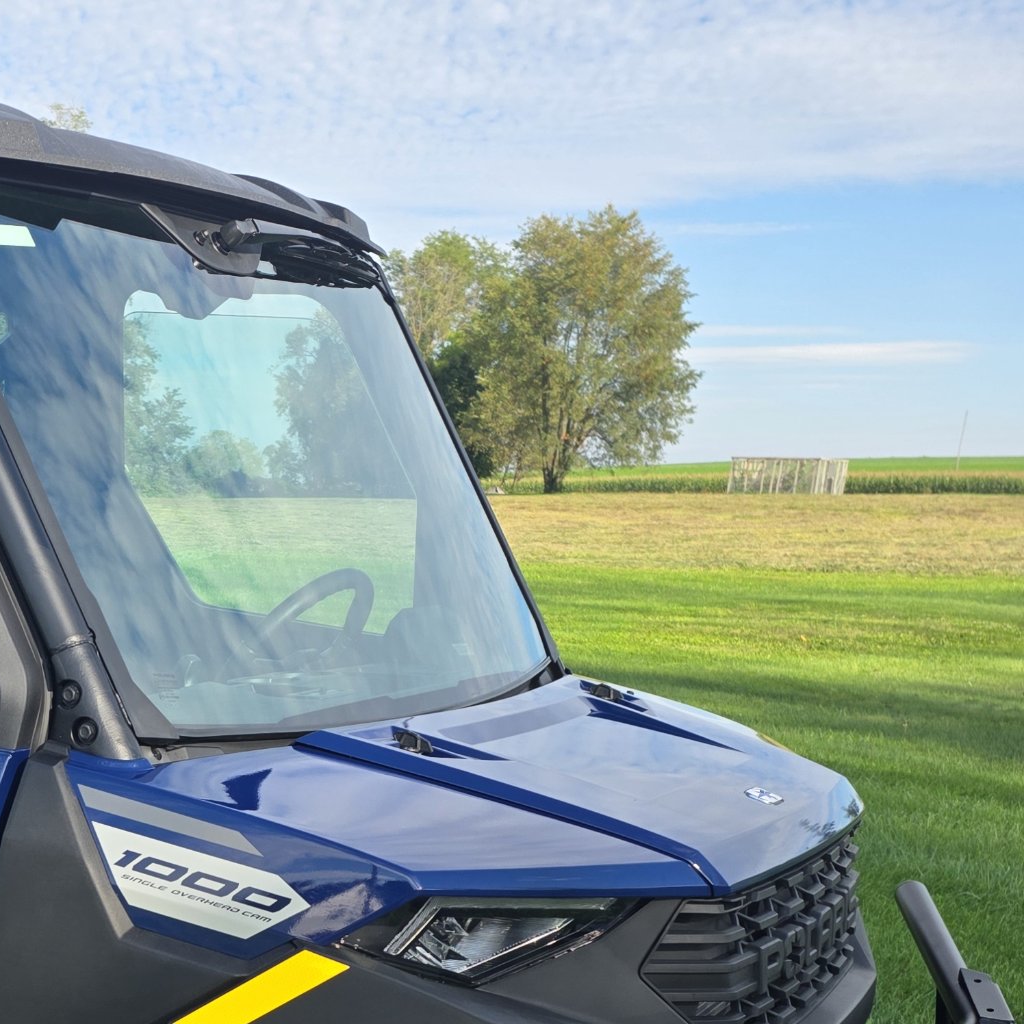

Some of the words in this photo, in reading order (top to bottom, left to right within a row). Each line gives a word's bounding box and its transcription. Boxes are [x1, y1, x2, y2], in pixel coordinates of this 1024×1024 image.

[114, 849, 292, 913] 1000
[121, 874, 168, 891] SINGLE
[170, 889, 241, 913] OVERHEAD
[241, 910, 273, 923] CAM
